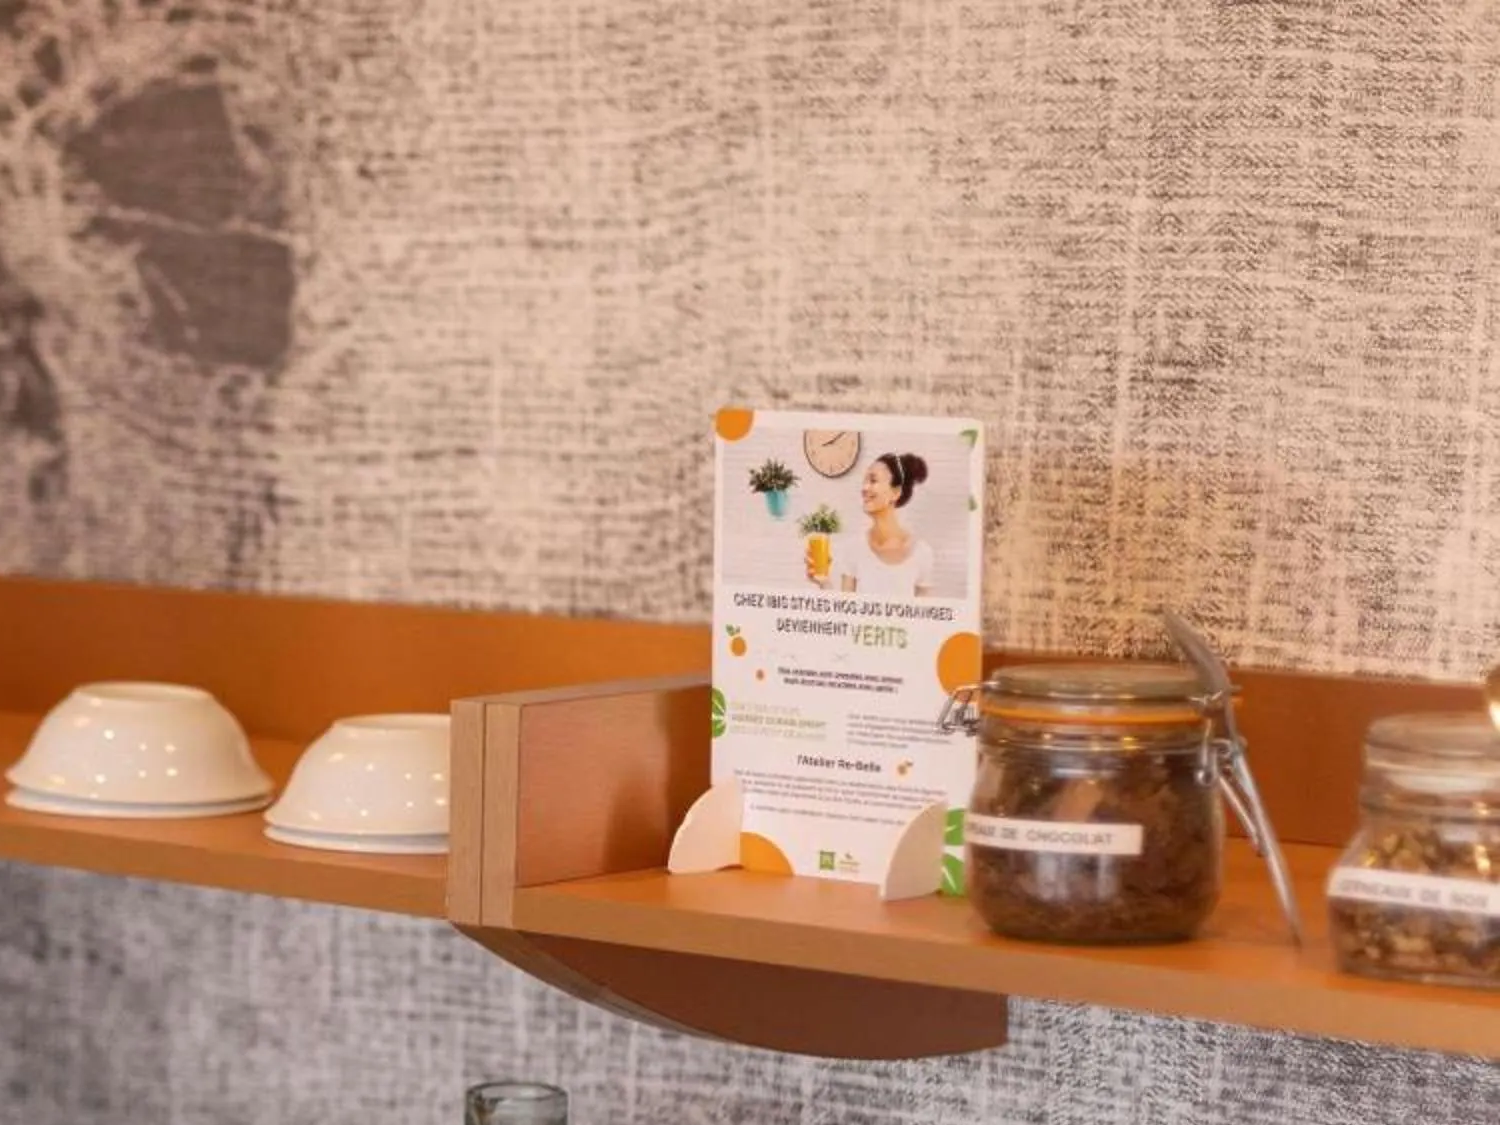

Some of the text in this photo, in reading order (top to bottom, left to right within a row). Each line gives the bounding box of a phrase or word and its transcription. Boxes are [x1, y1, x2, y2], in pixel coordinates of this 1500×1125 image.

[734, 592, 956, 621] CHEZ IBIS STYLES NOS JUS D'ORANGES
[776, 618, 908, 648] DEVIENNENT VERTS
[1001, 826, 1017, 840] DE
[1026, 828, 1114, 846] CHOCOLAT
